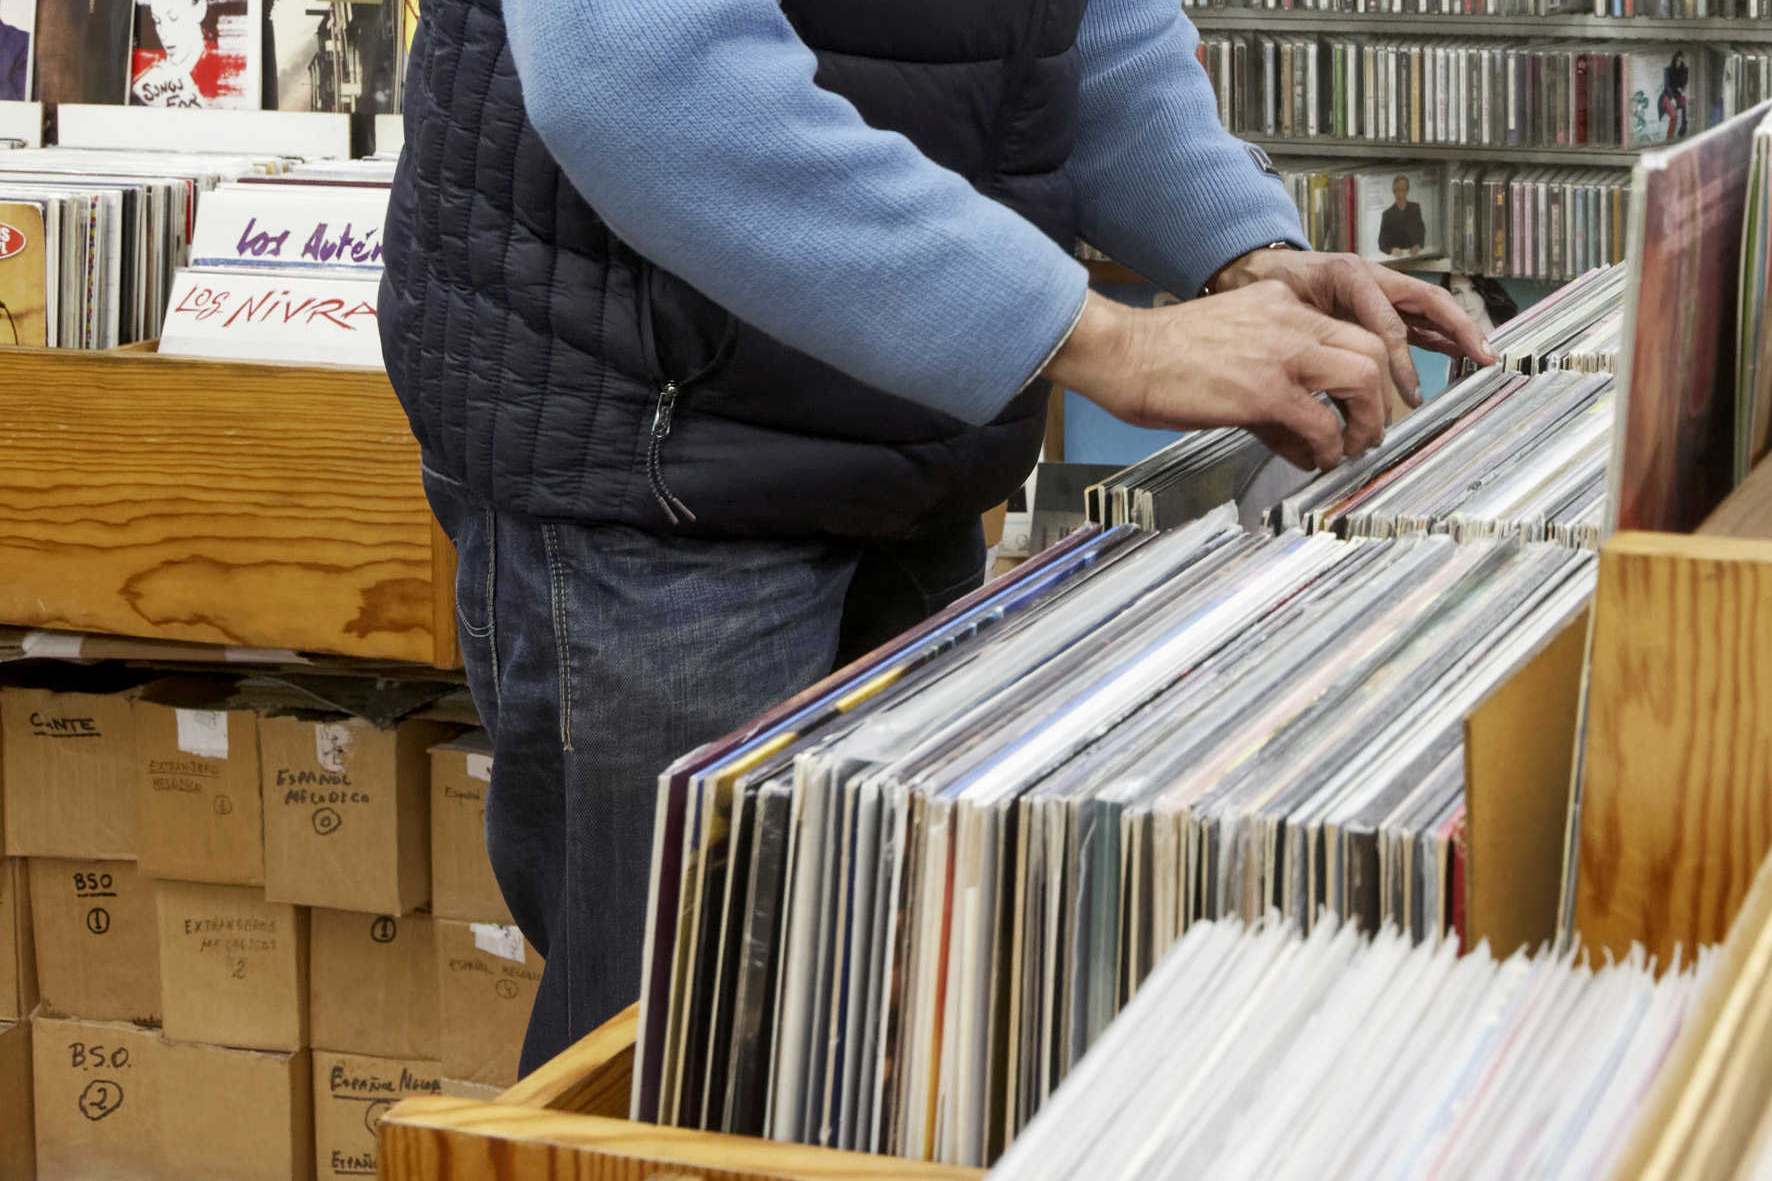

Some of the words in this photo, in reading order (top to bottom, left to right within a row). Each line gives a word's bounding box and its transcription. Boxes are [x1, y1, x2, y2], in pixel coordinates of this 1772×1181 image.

[236, 217, 292, 258] Los
[73, 872, 113, 892] BSO
[69, 1042, 132, 1072] B.S.O.
